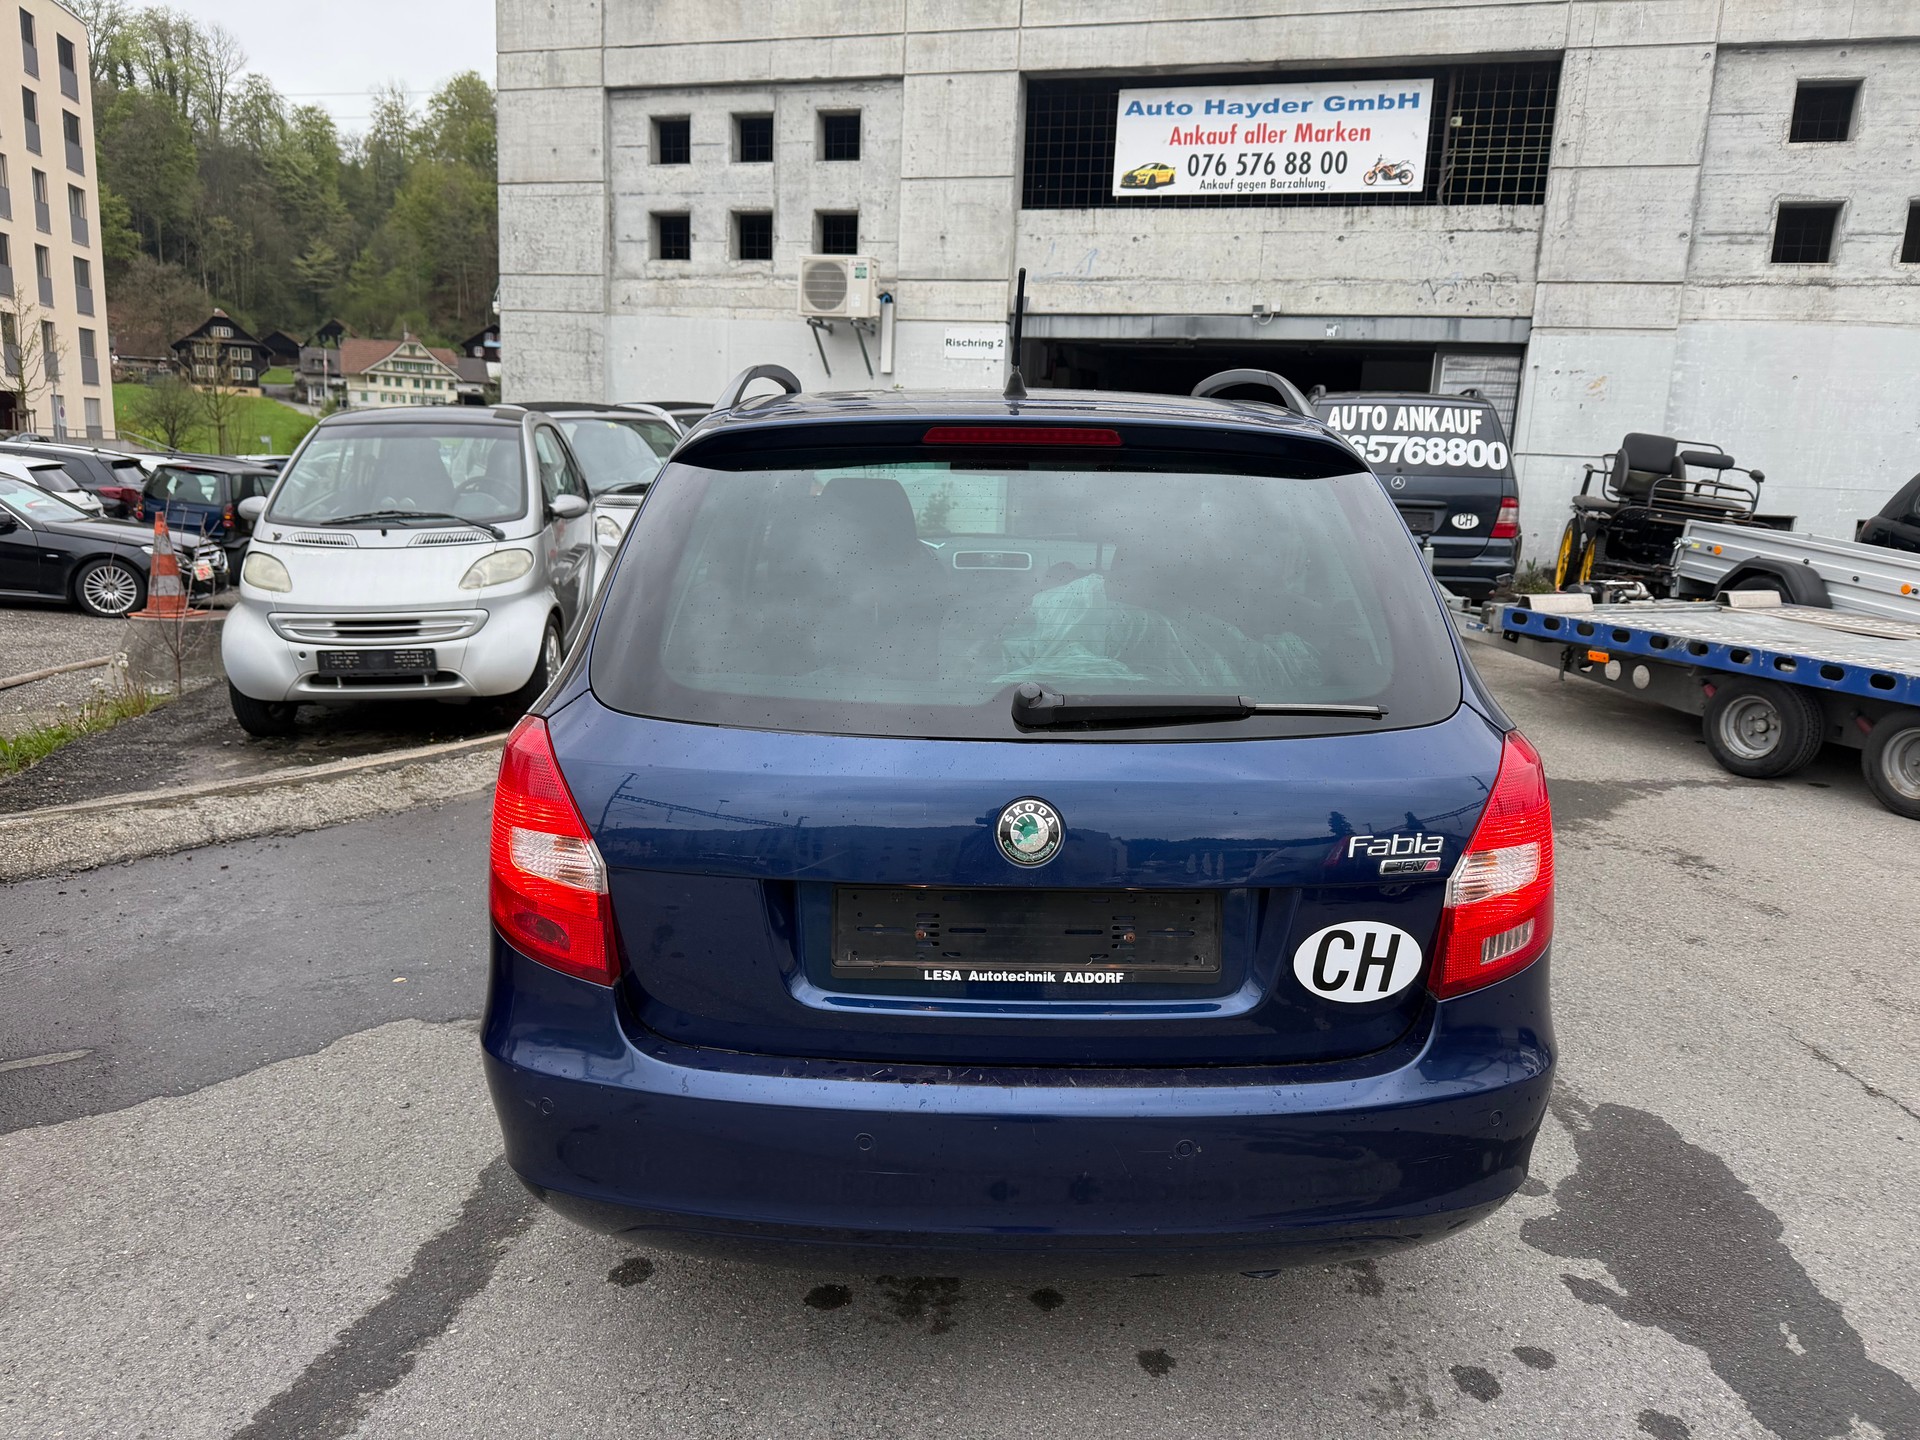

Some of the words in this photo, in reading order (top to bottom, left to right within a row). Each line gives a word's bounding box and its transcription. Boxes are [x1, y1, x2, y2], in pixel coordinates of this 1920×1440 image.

[1124, 100, 1194, 116] Auto
[1203, 96, 1314, 118] Hayder
[1323, 92, 1420, 113] GmbH
[1169, 123, 1238, 146] Ankauf
[1244, 122, 1287, 144] aller
[1293, 120, 1372, 143] Marken
[1187, 153, 1228, 177] 076
[1235, 152, 1277, 176] 576
[1284, 151, 1312, 175] 88
[1320, 150, 1348, 174] 00
[1199, 179, 1235, 190] Ankauf
[1237, 179, 1267, 192] gegen
[1269, 177, 1327, 191] Barzahlung
[945, 338, 994, 349] Rischring
[997, 338, 1004, 348] 2
[1327, 405, 1388, 431] AUTO
[1392, 406, 1483, 435] ANKAUF
[1341, 434, 1508, 470] 65768800
[1457, 513, 1474, 527] CH
[1347, 833, 1444, 858] Fabia
[1312, 929, 1402, 992] CH
[923, 970, 962, 982] LESA
[968, 970, 1056, 983] Autotechnik
[1063, 972, 1125, 984] AADORF
